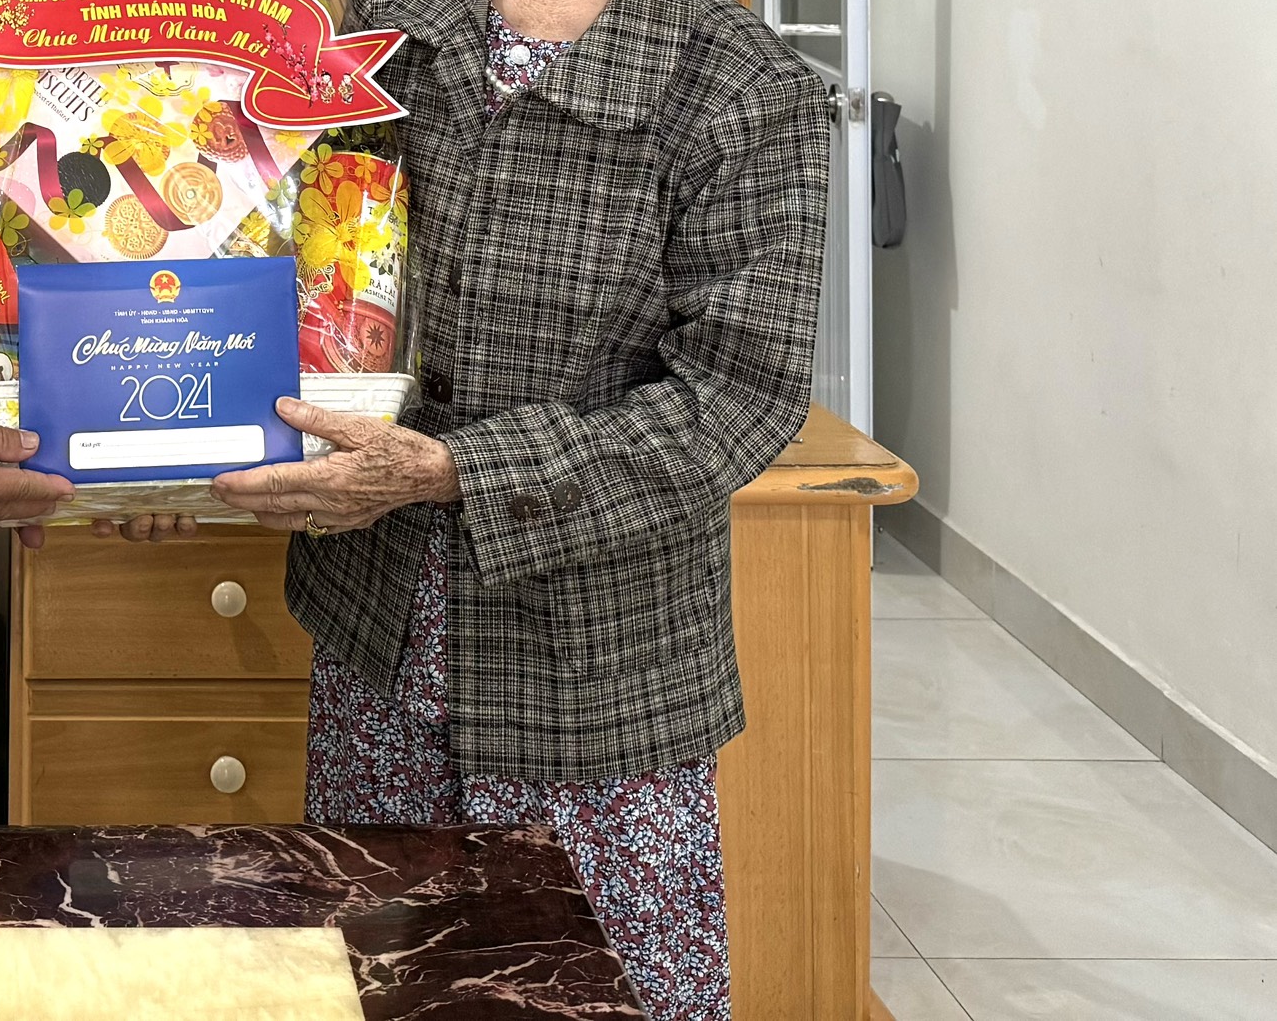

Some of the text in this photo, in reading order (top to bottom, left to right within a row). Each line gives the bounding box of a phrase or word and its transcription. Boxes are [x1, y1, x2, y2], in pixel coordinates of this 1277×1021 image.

[80, 1, 227, 22] TỈNH KHÁNH HÒA
[259, 0, 293, 25] NAM
[22, 20, 271, 59] Chúc Mừng Năm Mới
[72, 329, 139, 365] Chúc
[129, 335, 180, 359] Mừng
[178, 331, 227, 357] Năm
[111, 363, 149, 371] HAPPY
[119, 372, 212, 422] 2024
